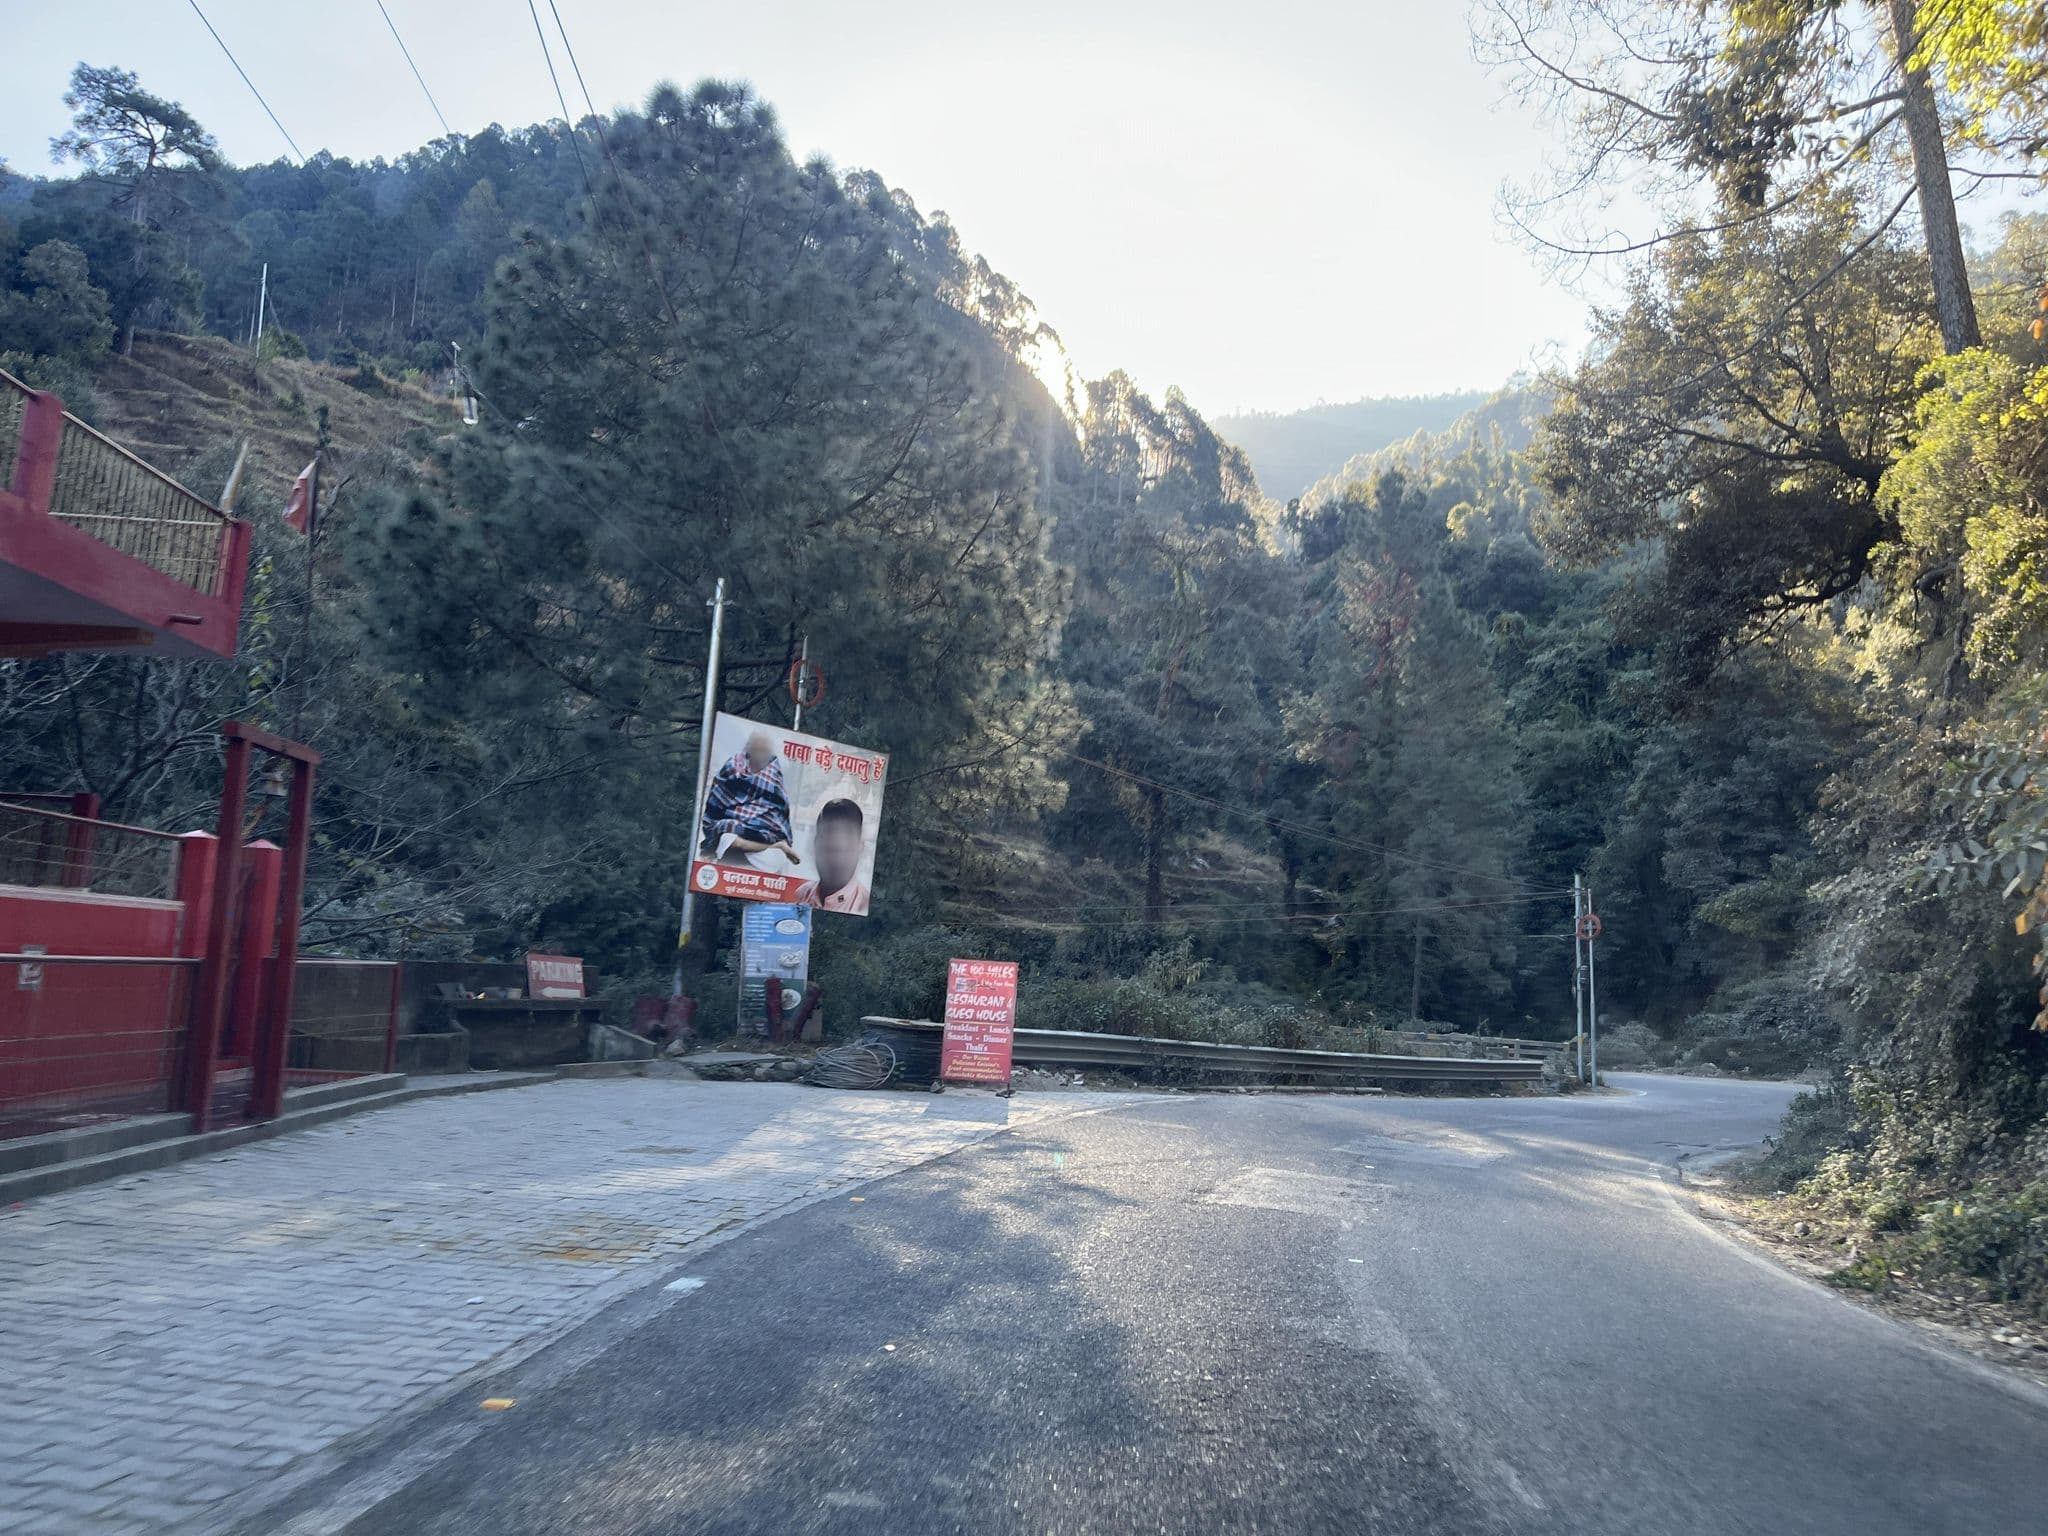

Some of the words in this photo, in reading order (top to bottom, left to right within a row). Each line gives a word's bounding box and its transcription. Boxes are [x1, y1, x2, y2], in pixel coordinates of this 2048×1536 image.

[783, 740, 812, 764] बाबा
[815, 745, 833, 774] बड़े
[837, 753, 870, 784] दयालु
[950, 963, 967, 975] THE
[946, 993, 1005, 1007] RESTAURANT
[945, 1007, 974, 1019] GUEST
[976, 1009, 1008, 1022] HOUSE
[989, 1025, 1011, 1034] Lunch
[983, 1034, 1008, 1043] Dinner
